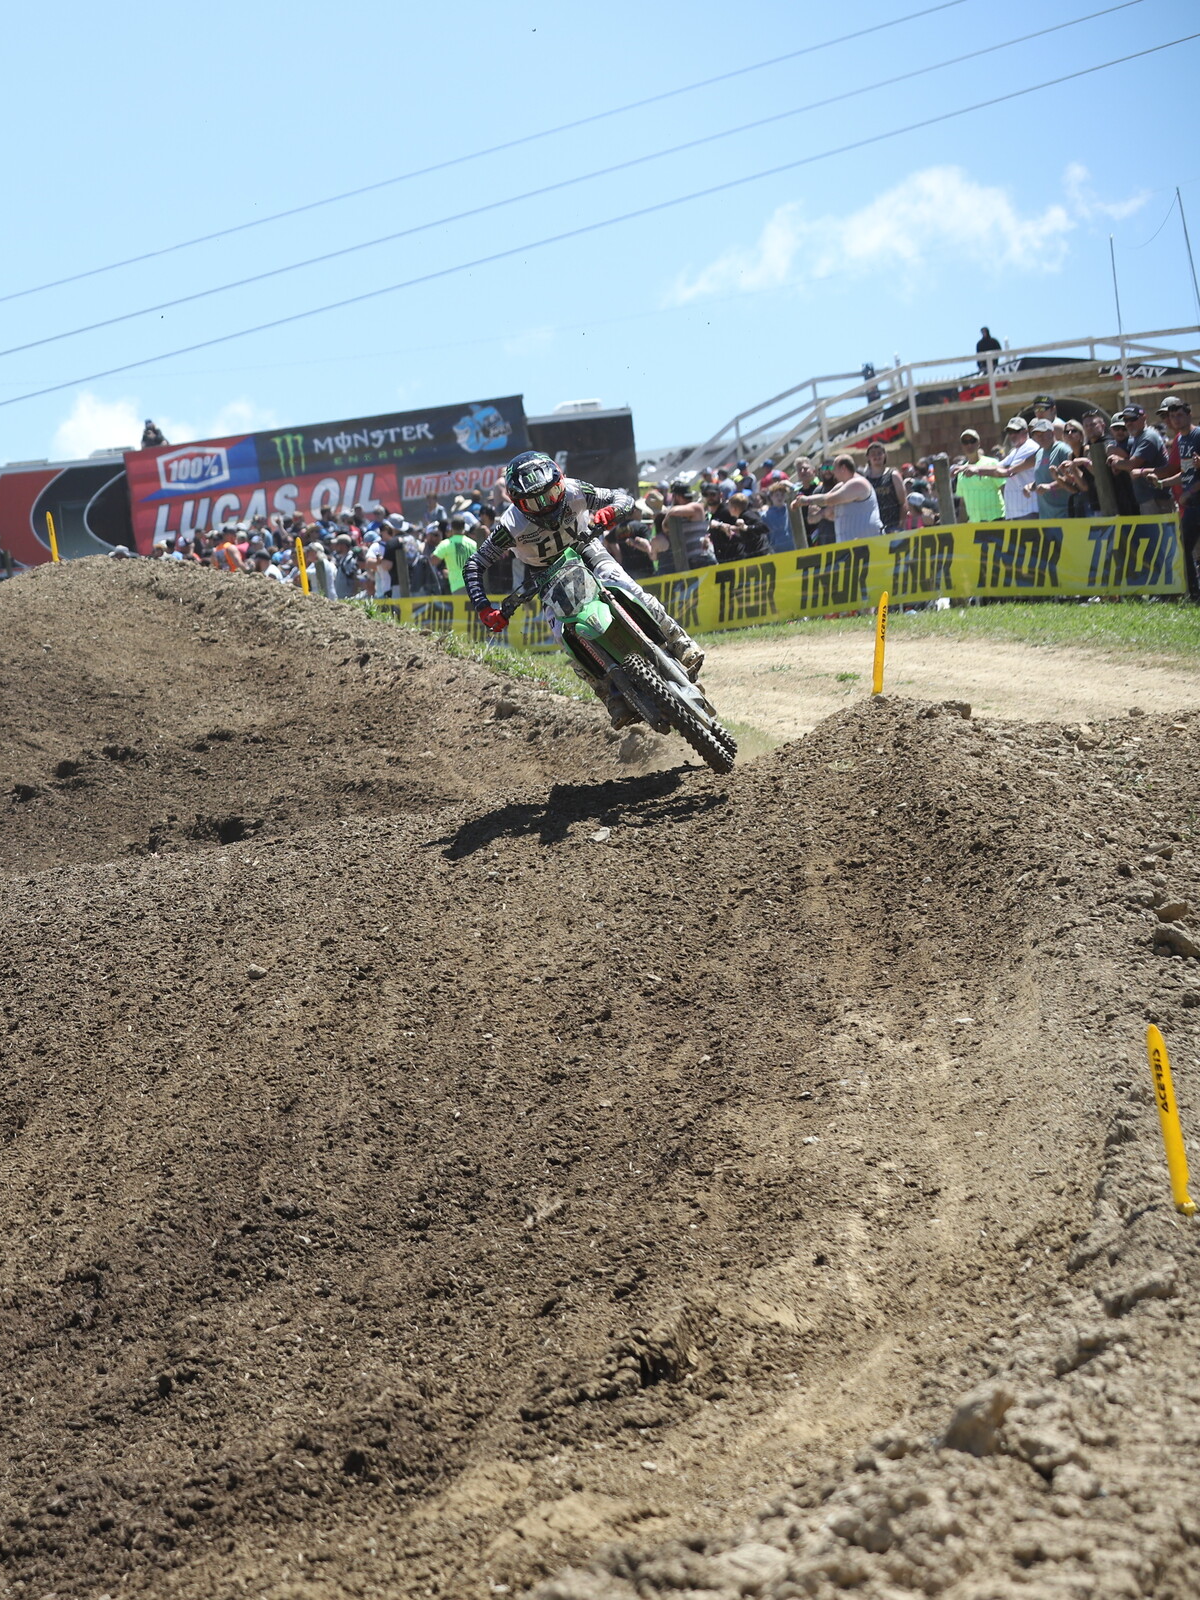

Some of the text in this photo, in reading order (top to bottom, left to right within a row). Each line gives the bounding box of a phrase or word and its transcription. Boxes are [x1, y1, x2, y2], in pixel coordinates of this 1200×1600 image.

[168, 454, 219, 482] 100%
[312, 422, 434, 454] MONSTER
[333, 446, 418, 465] ENERGY
[152, 472, 380, 549] LUCAS OIL
[536, 519, 580, 558] FLY
[796, 544, 870, 610] THOR
[889, 532, 955, 597] THOR
[973, 527, 1063, 588] THOR
[1087, 522, 1178, 587] THOR
[715, 561, 778, 623] THOR
[1153, 1048, 1170, 1113] ACERBIS
